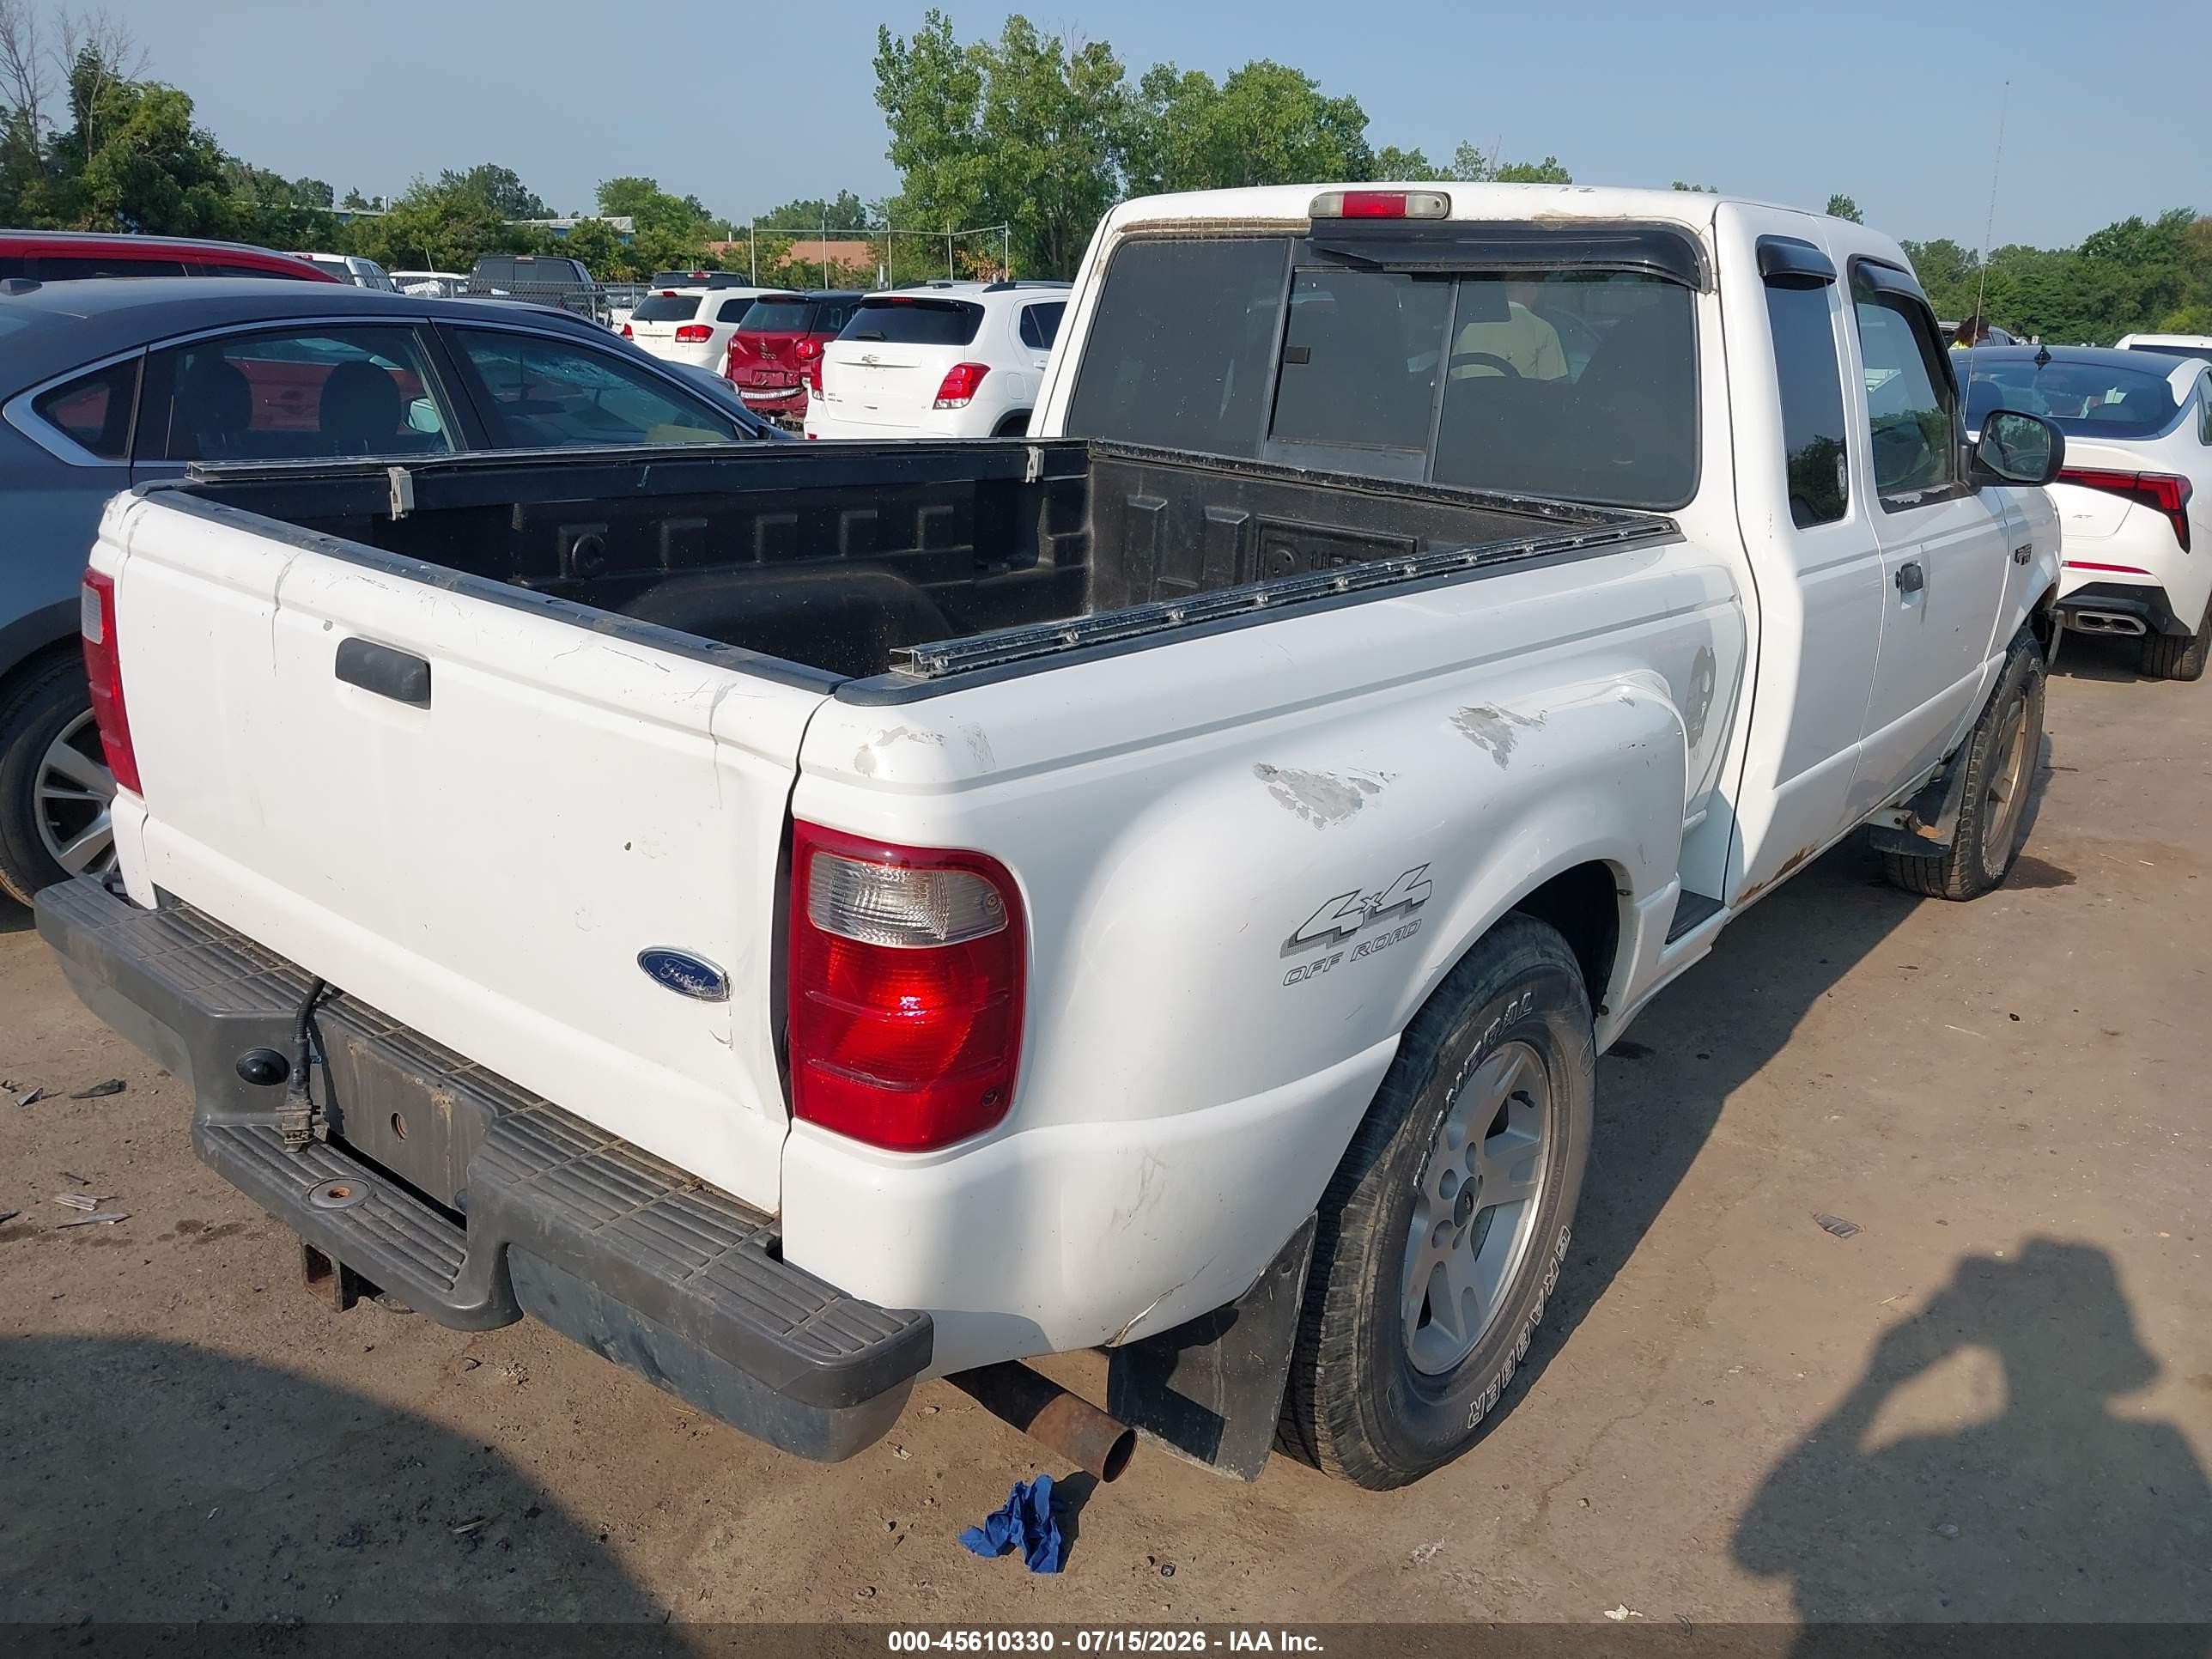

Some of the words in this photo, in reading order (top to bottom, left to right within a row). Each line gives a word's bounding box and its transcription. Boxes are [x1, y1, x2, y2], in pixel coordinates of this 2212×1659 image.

[1283, 951, 1344, 987] OFF
[1349, 919, 1422, 963] ROAD
[1413, 992, 1533, 1194] NERAL
[1467, 1224, 1571, 1430] GRABBER
